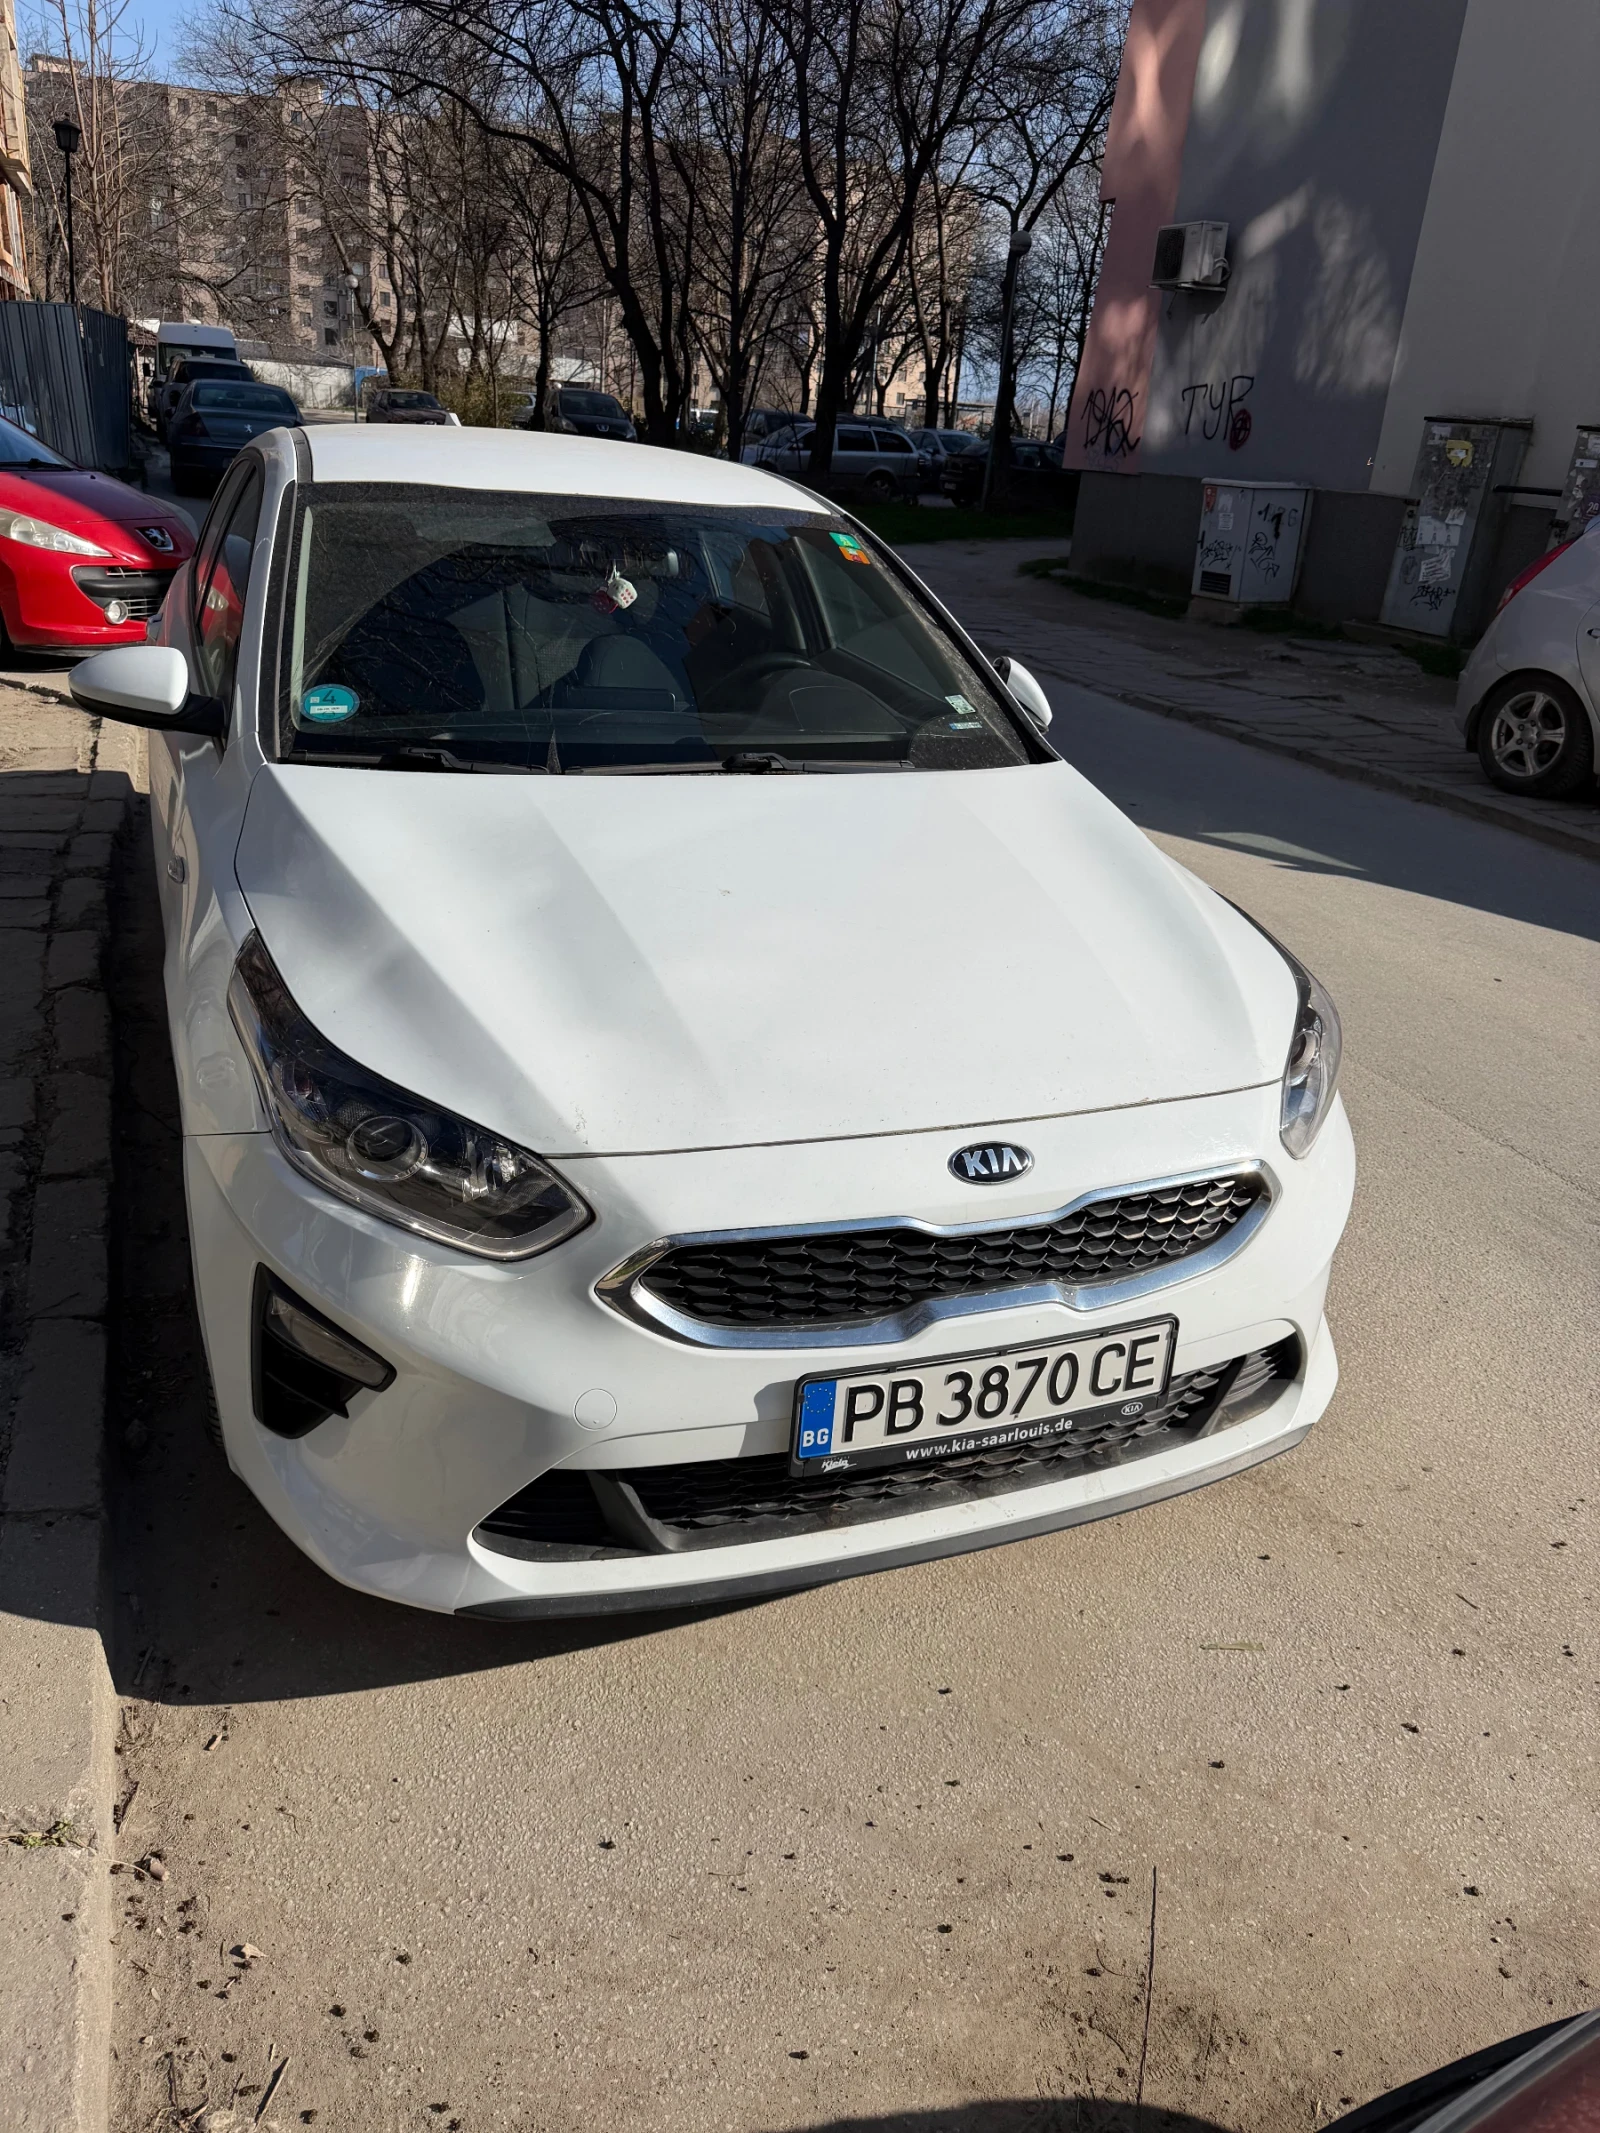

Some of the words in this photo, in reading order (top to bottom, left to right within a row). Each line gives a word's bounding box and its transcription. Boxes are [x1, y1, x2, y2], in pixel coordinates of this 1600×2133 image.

[322, 689, 337, 704] 4
[962, 1147, 1023, 1177] KIA
[841, 1379, 924, 1443] PB
[936, 1350, 1079, 1426] 3870
[1089, 1334, 1160, 1397] CE
[802, 1428, 829, 1448] BG
[905, 1418, 1073, 1460] www.kia-saarlouis.de
